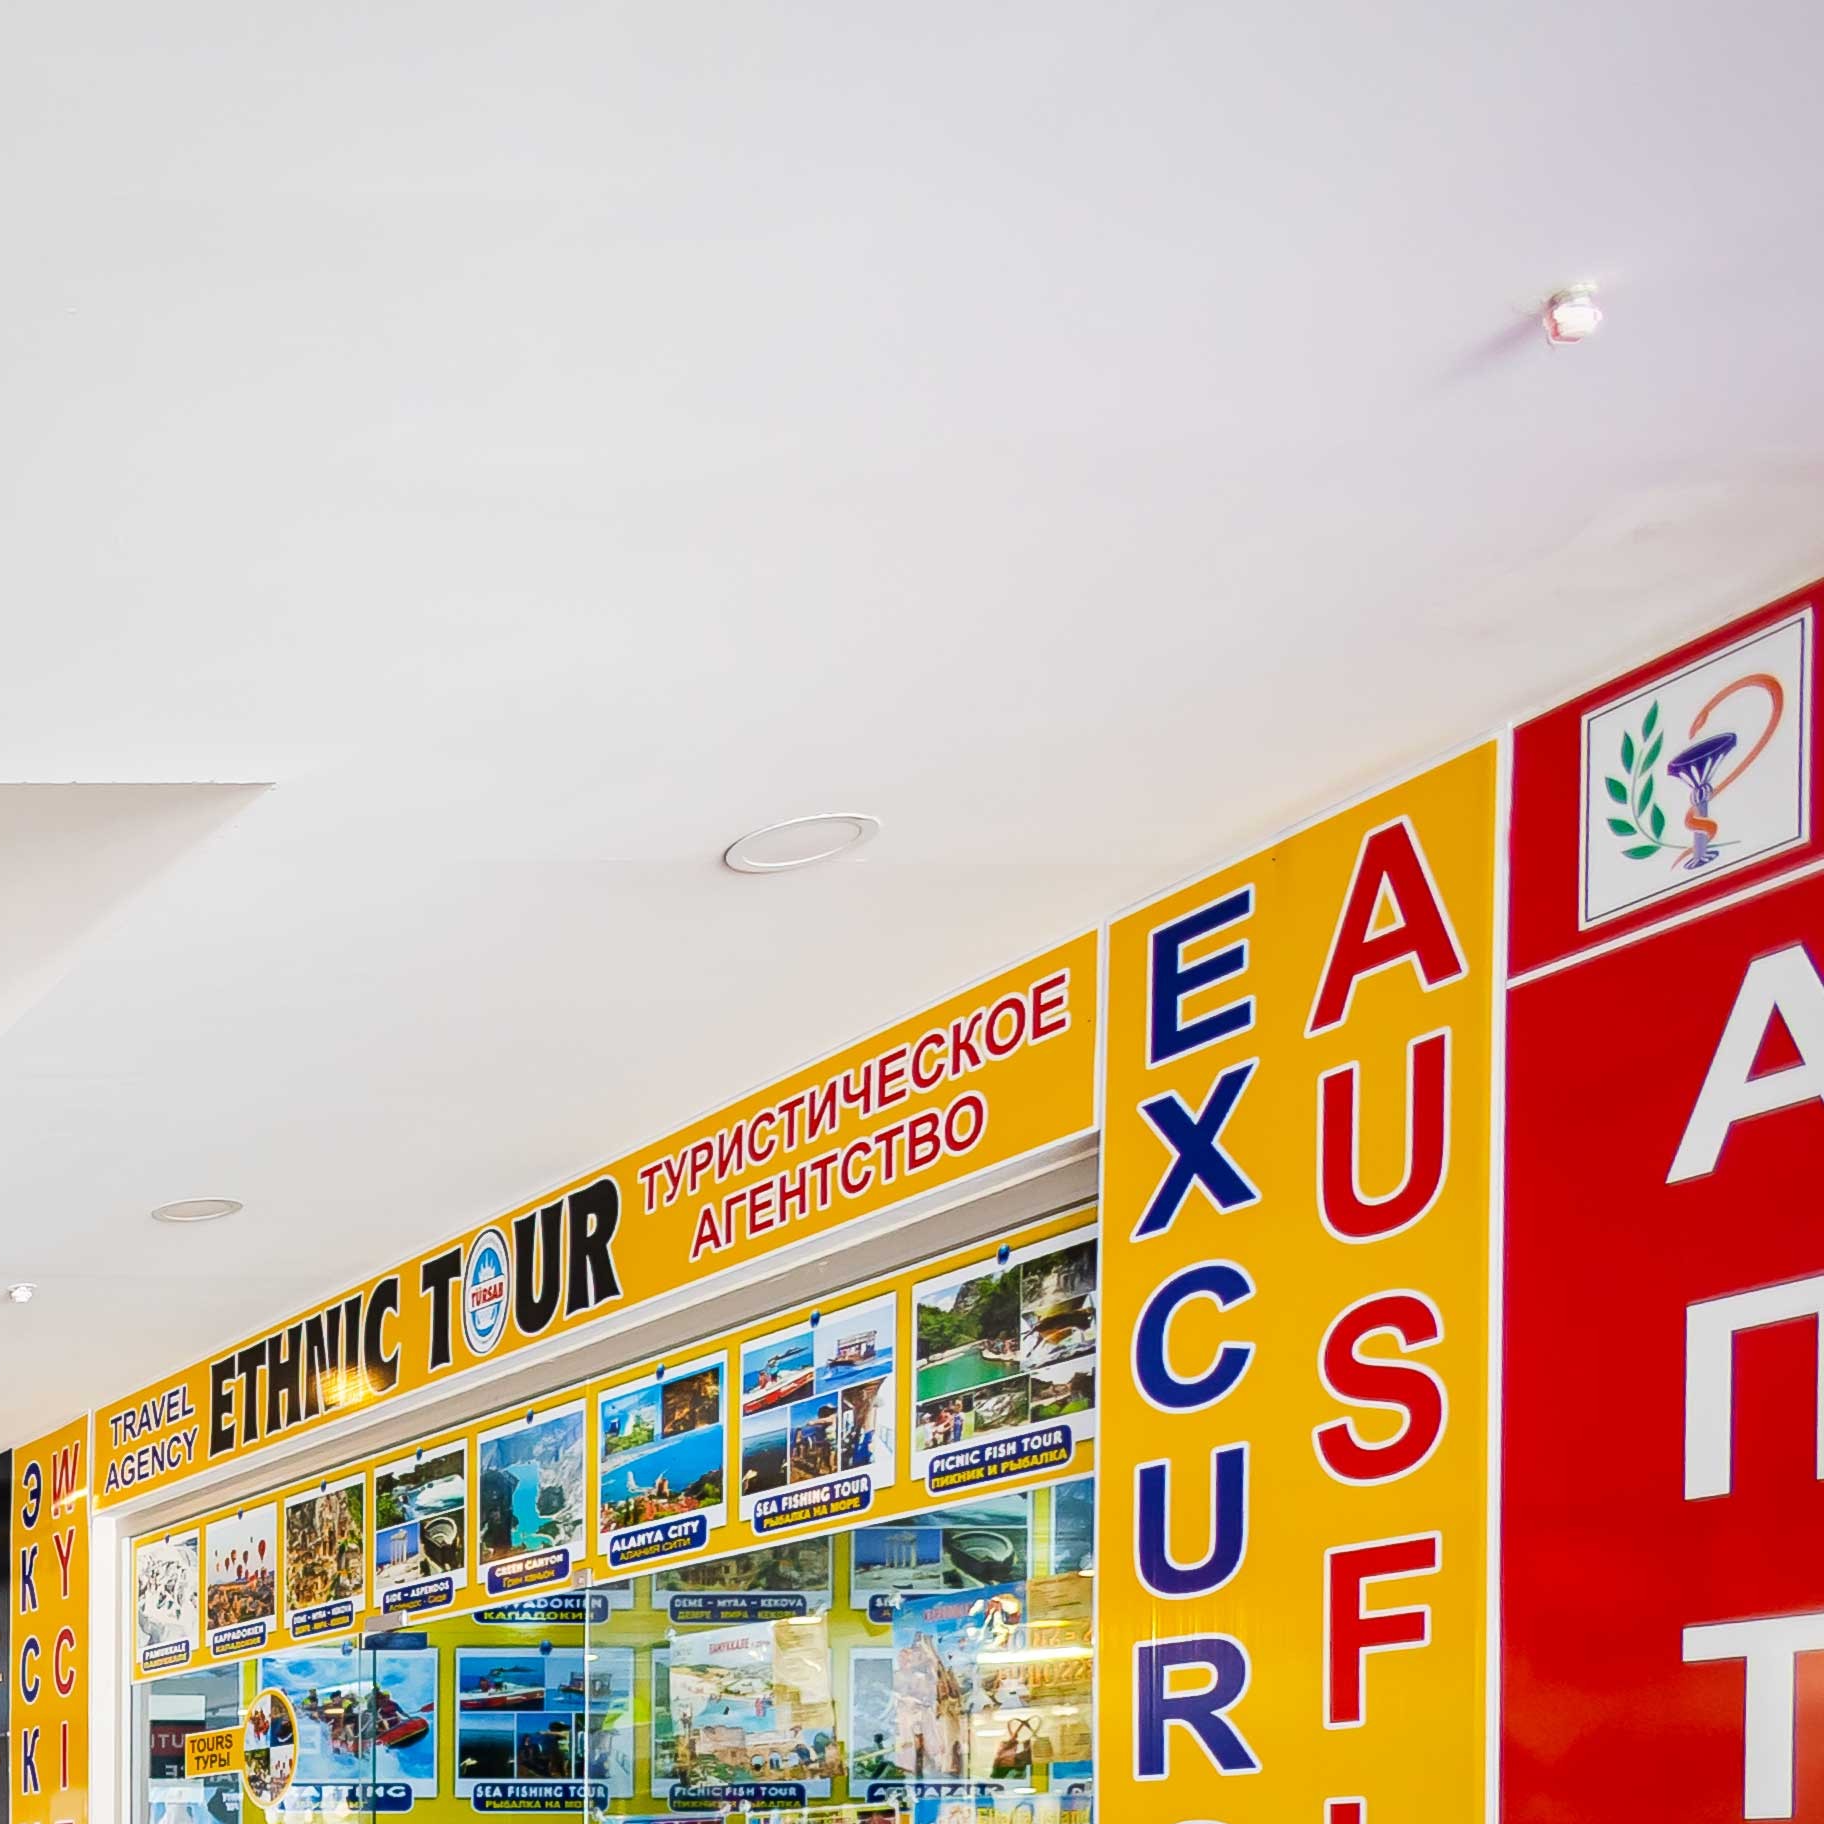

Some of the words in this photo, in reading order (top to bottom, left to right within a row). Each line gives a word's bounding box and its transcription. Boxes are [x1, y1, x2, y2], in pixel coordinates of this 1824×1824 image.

[639, 973, 1067, 1211] ТУРИСТИЧЕСКОЕ
[691, 1095, 984, 1259] АГЕНТСТВО
[209, 1276, 401, 1458] ETHNIC
[421, 1178, 623, 1370] TOUR
[110, 1386, 195, 1449] TRAVEL
[104, 1427, 199, 1494] AGENCY
[931, 1469, 984, 1490] ПИКНИК
[988, 1467, 997, 1478] И
[1000, 1448, 1068, 1474] РЫБАЛКА
[933, 1450, 980, 1473] PICNIC
[984, 1440, 1016, 1463] FISH
[1021, 1430, 1063, 1455] TOUR
[756, 1498, 778, 1518] SEA
[781, 1486, 830, 1512] FISHING
[833, 1478, 869, 1499] TOUR
[763, 1509, 810, 1529] РЫБАЛКА
[813, 1506, 828, 1519] НА
[830, 1497, 860, 1514] МОРЕ
[611, 1528, 664, 1553] ALANYA
[669, 1520, 700, 1539] CITY
[386, 1590, 402, 1603] SIDE
[410, 1581, 449, 1598] ASPENDOS
[189, 1733, 233, 1754] TOURS
[195, 1749, 230, 1768] ТУРЫ
[476, 1785, 501, 1798] SEA
[507, 1786, 561, 1798] FISHING
[674, 1786, 721, 1797] PICNIC
[724, 1786, 754, 1797] FISH
[759, 1786, 797, 1797] TOUR
